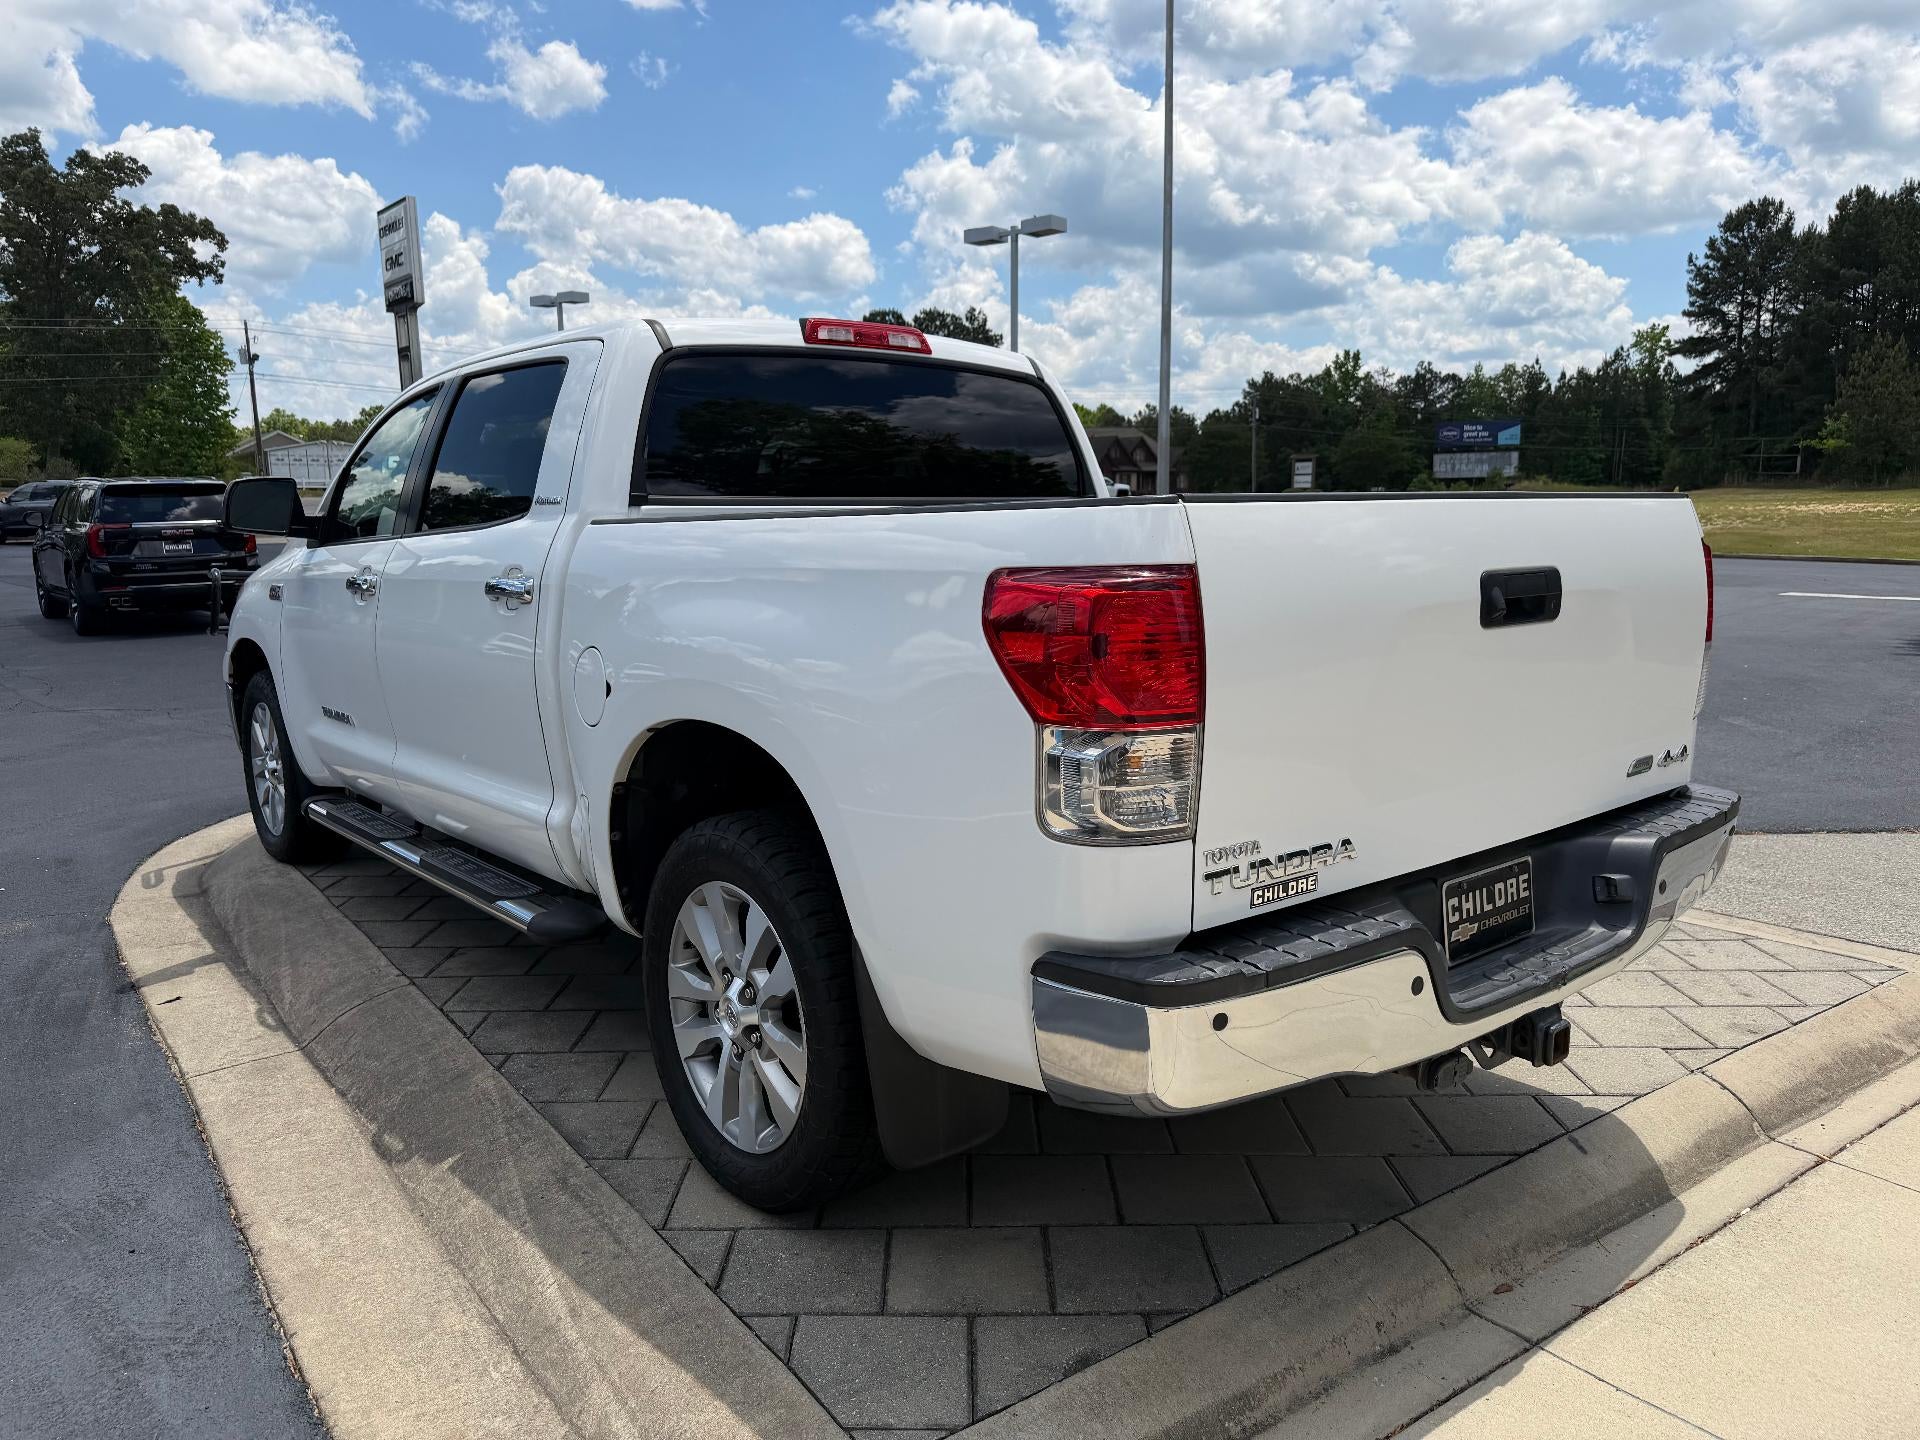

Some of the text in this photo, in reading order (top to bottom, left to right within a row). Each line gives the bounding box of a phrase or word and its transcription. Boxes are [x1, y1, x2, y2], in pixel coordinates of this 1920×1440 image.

[385, 251, 404, 272] GMC
[1202, 837, 1358, 895] TUNDRA
[1203, 840, 1261, 866] TOYOTA
[1253, 875, 1317, 905] CHILDRE
[1447, 873, 1530, 924] CHILDRE
[1480, 904, 1530, 931] CHEVROLET
